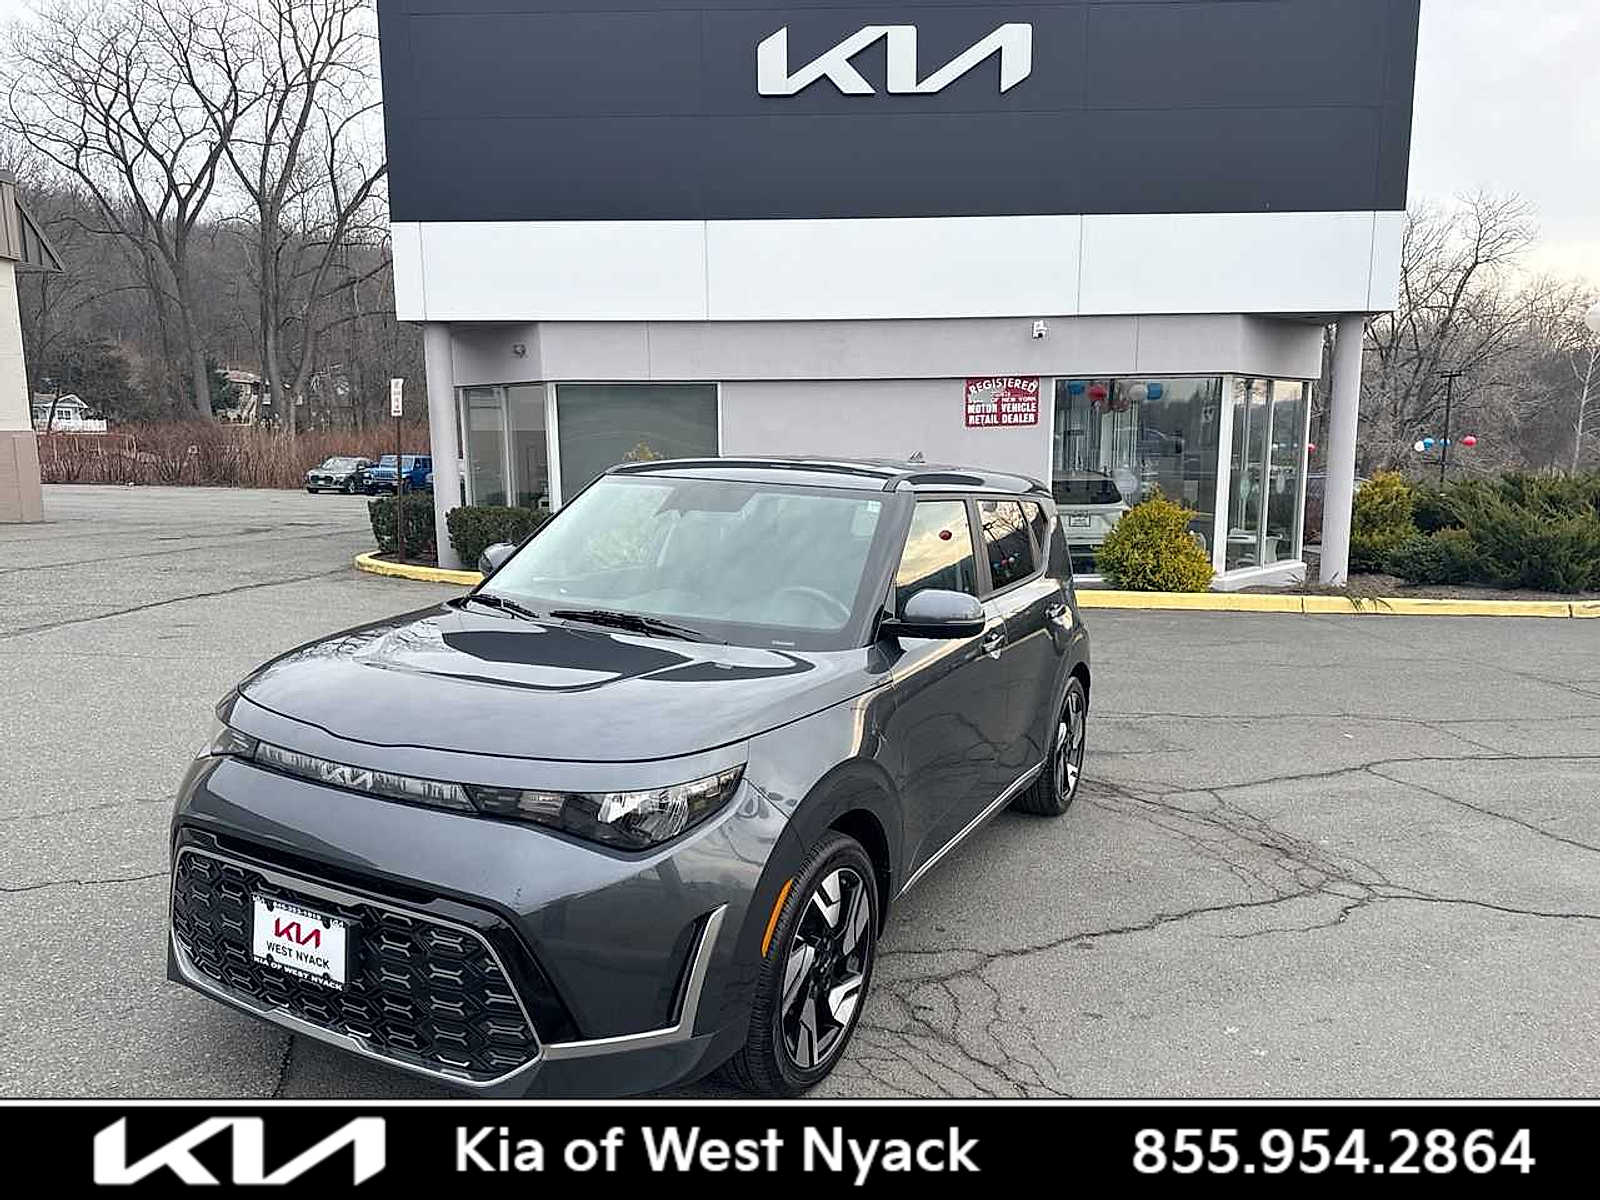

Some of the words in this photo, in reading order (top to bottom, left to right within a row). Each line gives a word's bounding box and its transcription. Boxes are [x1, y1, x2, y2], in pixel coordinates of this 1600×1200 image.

[758, 23, 1032, 95] KIA
[968, 378, 1039, 395] REGISTERED
[968, 403, 998, 414] MOTOR
[1001, 402, 1037, 413] VEHICLE
[968, 414, 999, 425] RETAIL
[1002, 413, 1035, 424] DEALER
[274, 917, 321, 949] KIA
[267, 940, 292, 958] WEST
[296, 950, 330, 969] NYACK
[254, 956, 269, 967] KIA
[271, 962, 282, 970] OF
[284, 966, 309, 979] WEST
[311, 976, 343, 991] NYACK
